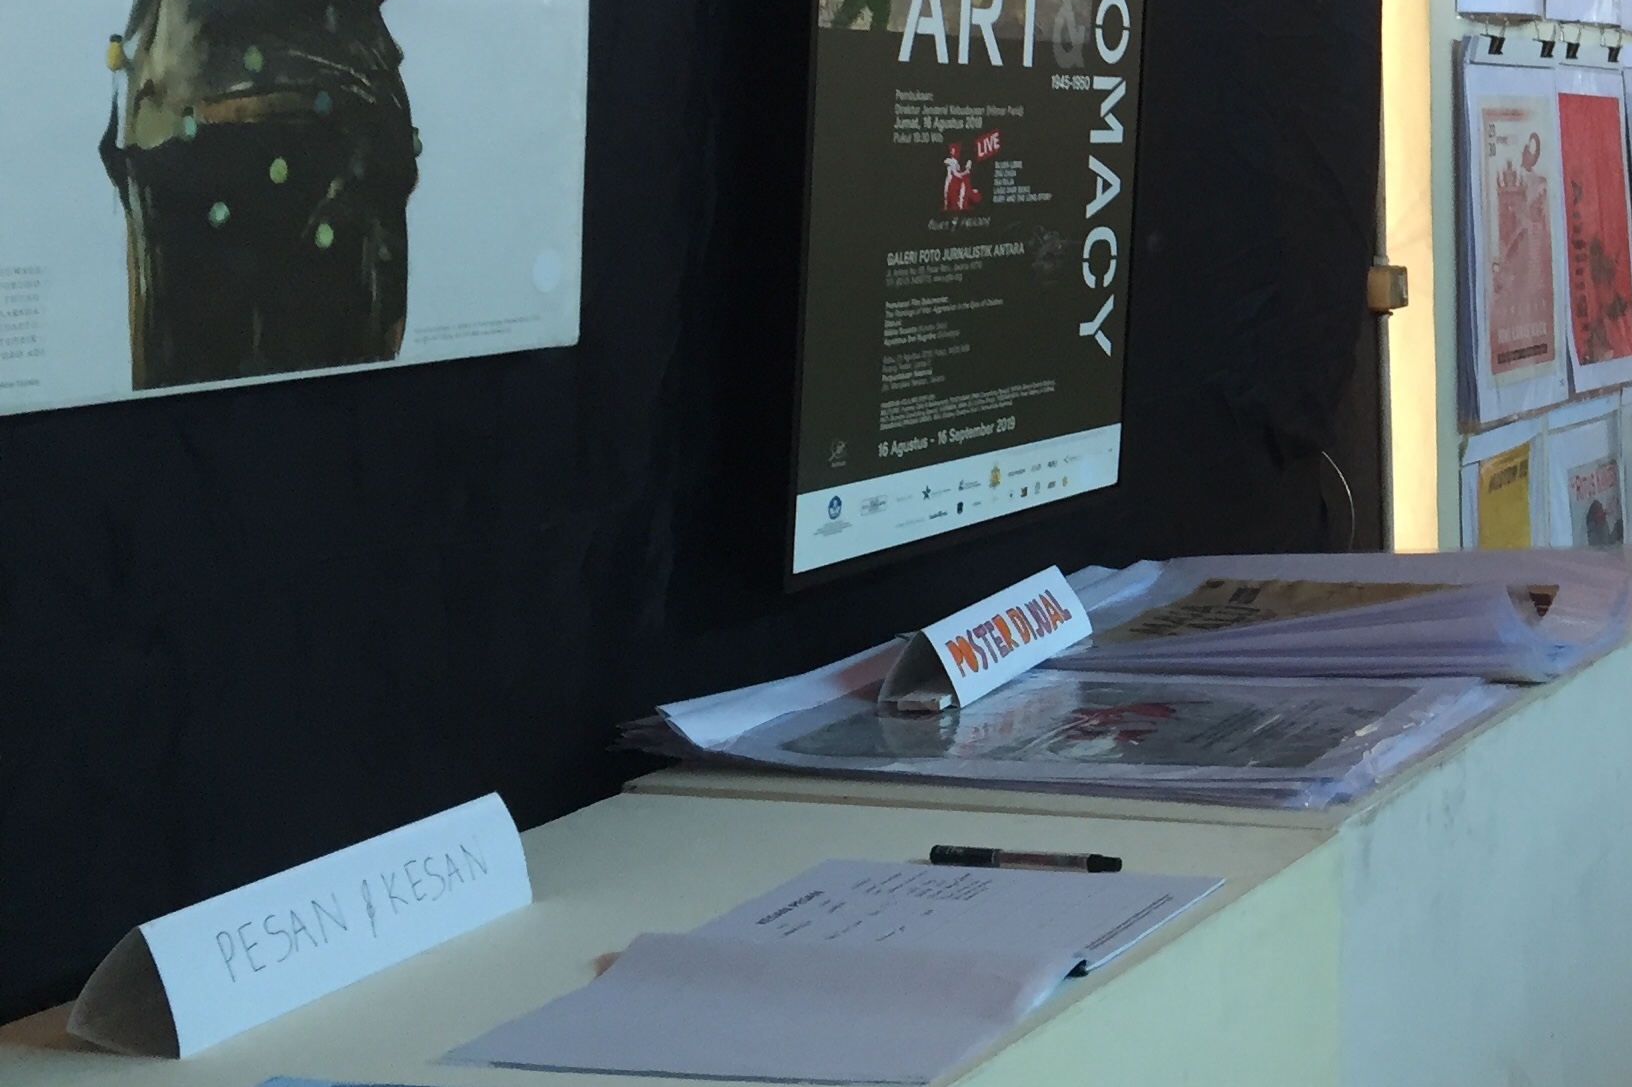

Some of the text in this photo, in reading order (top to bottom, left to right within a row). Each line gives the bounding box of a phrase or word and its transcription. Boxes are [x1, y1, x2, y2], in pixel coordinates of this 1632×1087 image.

[977, 131, 1000, 158] LIVE
[919, 248, 941, 263] FOTO
[878, 440, 889, 458] 16
[890, 435, 929, 457] Agustus
[937, 429, 948, 445] 16
[949, 422, 995, 445] September
[945, 614, 1019, 677] POSTER
[215, 893, 348, 983] PESAN
[380, 836, 490, 915] KESAN
